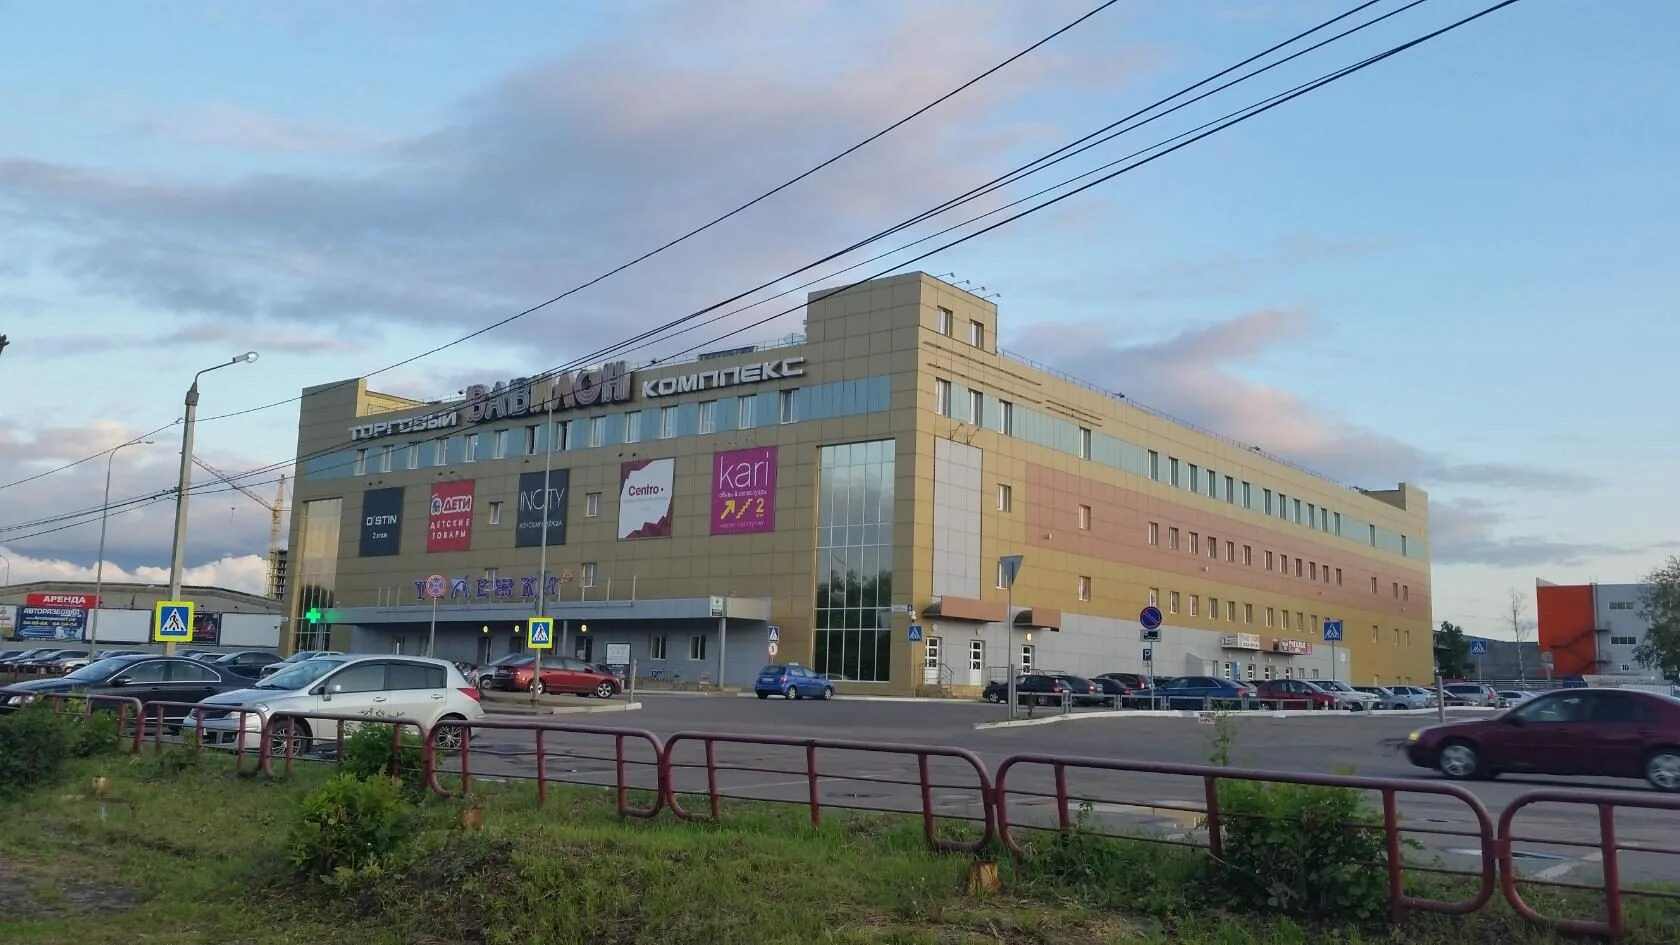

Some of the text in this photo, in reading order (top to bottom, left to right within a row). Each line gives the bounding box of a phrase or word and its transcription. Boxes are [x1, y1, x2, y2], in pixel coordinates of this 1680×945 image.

[349, 408, 457, 441] ТОРГОВЫЙ
[465, 360, 633, 422] ВАВИЛОН
[719, 451, 769, 490] kari
[628, 484, 659, 496] Centro
[441, 495, 472, 513] ДЕТИ
[519, 487, 565, 512] INCTY
[756, 498, 764, 513] 2
[430, 518, 470, 529] ДЕТСКИЕ
[432, 530, 466, 540] ТОВАРЫ
[43, 596, 86, 604] АРЕНДА
[1144, 650, 1151, 660] P
